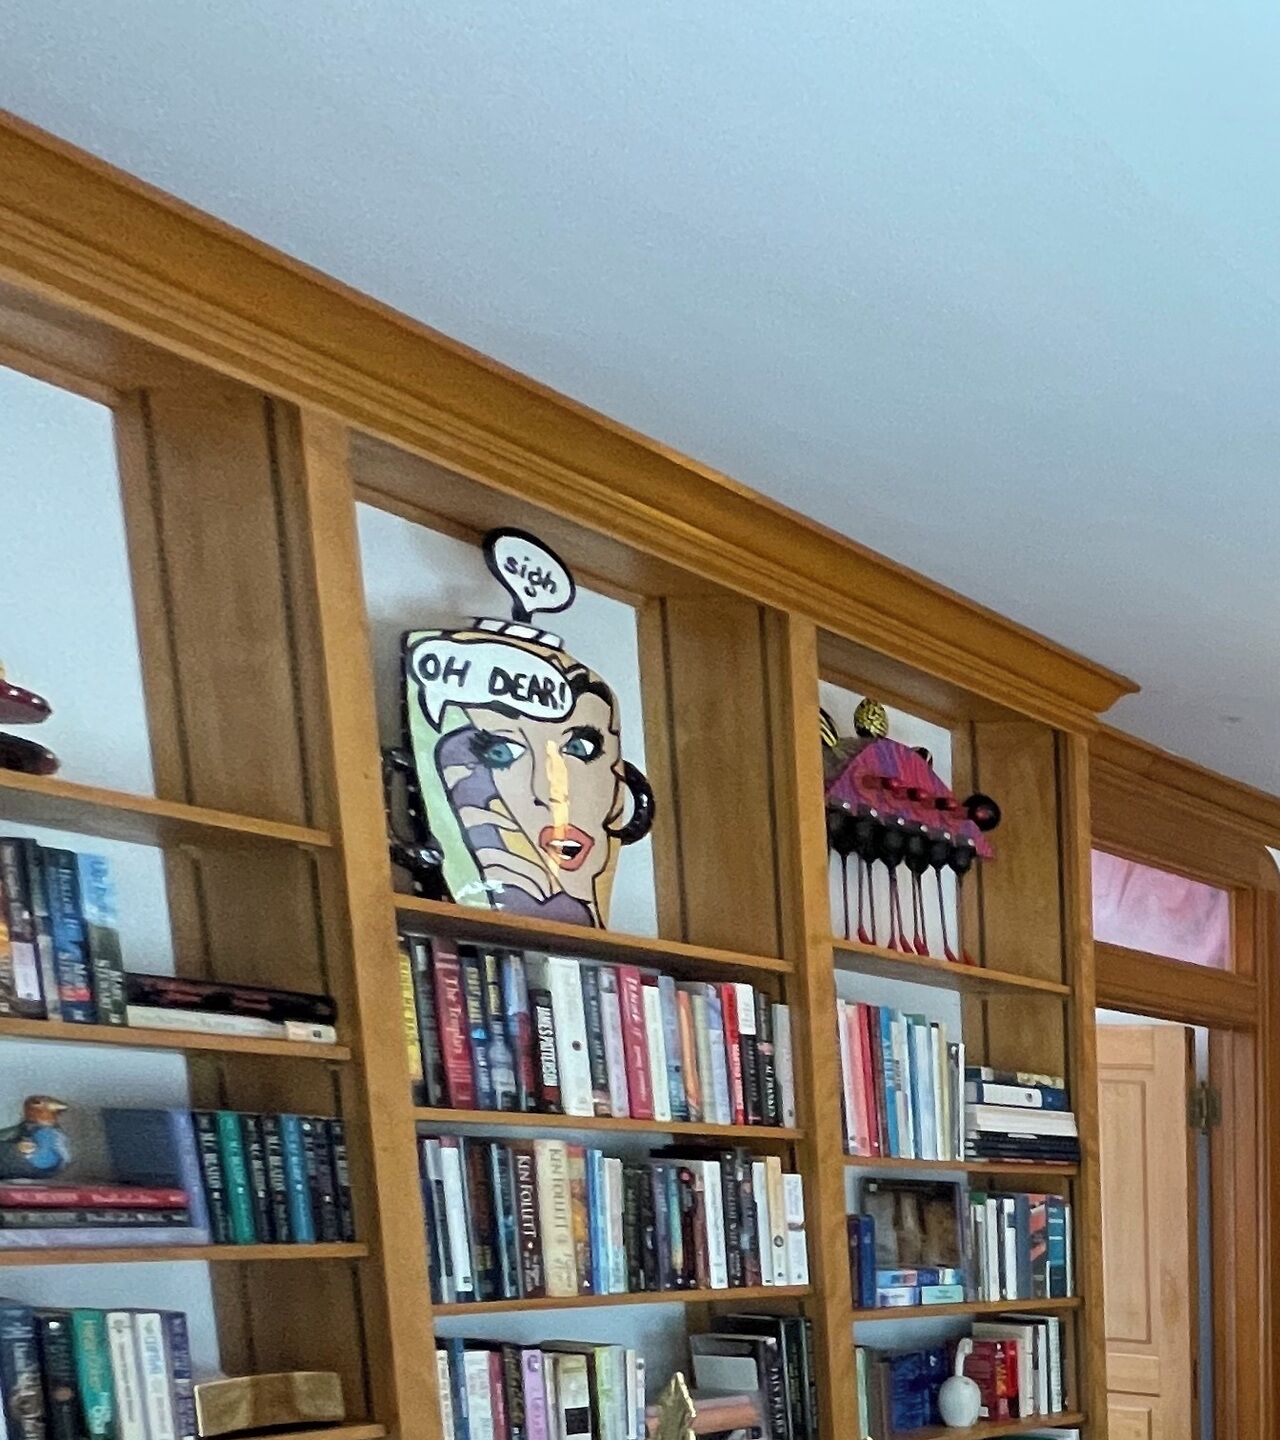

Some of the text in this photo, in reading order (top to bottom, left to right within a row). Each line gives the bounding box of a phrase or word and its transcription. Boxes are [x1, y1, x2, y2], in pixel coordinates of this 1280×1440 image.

[504, 556, 557, 598] sigh
[418, 653, 566, 710] OH DEAR!
[444, 977, 465, 1054] The Templars
[536, 1006, 558, 1087] JAMES PATTERSON
[516, 1155, 532, 1181] KEN
[549, 1148, 568, 1228] KEN FOLLETT
[520, 1184, 537, 1238] FOLLETT
